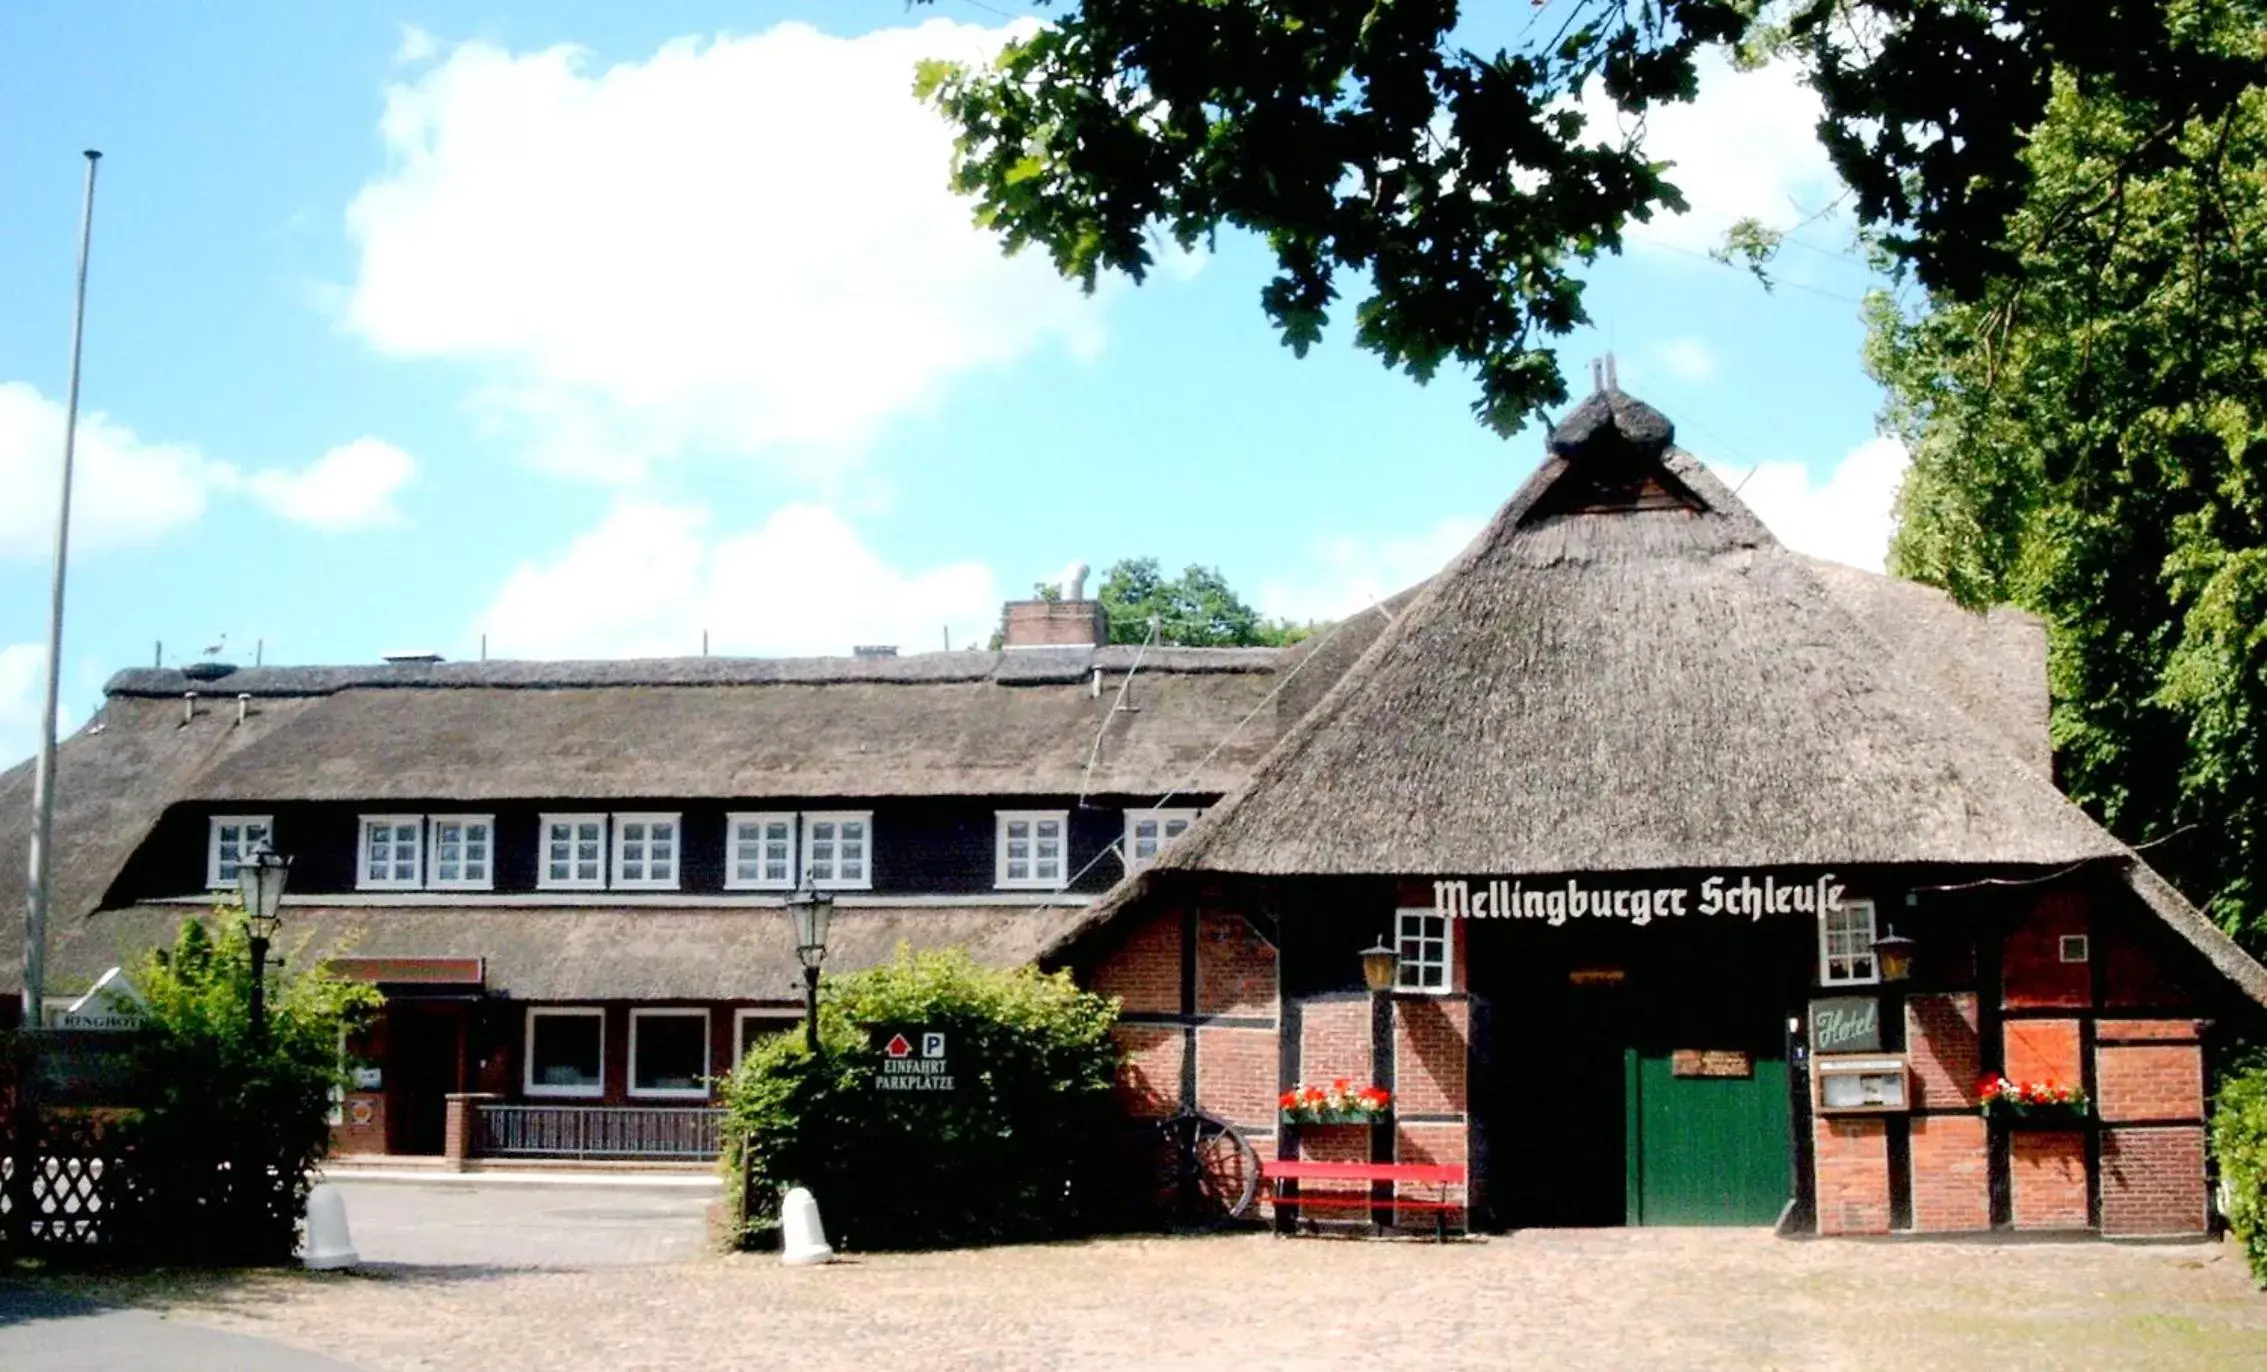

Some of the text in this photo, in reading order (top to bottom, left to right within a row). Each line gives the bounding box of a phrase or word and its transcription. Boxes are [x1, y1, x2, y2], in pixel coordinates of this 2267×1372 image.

[1433, 879, 1687, 927] Mellingburger
[1816, 1002, 1876, 1048] Hotel
[926, 1035, 941, 1055] P
[884, 1059, 947, 1074] EINFAHRT
